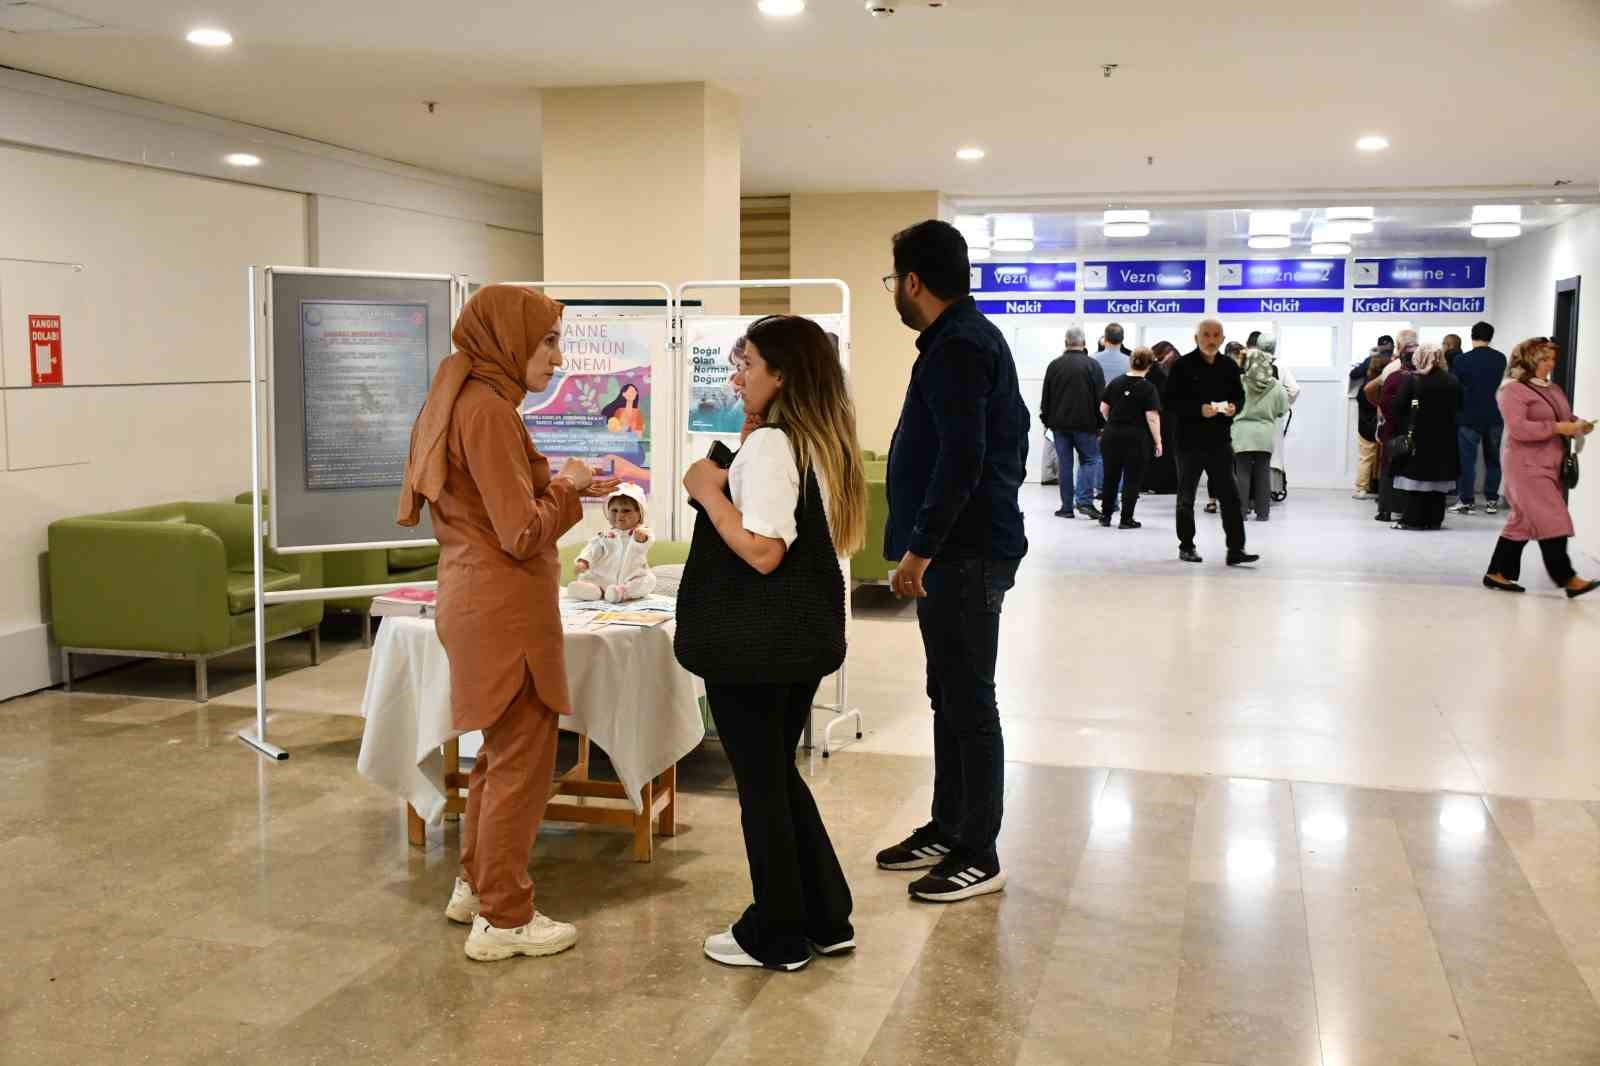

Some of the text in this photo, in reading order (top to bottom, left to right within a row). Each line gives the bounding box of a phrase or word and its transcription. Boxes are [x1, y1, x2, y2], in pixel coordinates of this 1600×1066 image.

[1183, 268, 1192, 282] 3
[1321, 268, 1330, 281] 2
[1464, 265, 1472, 279] 1
[1005, 300, 1041, 312] Nakit
[1107, 299, 1180, 312] Kredi Kartı
[1260, 299, 1300, 312] Nakit
[1354, 298, 1394, 311] Kredi
[32, 319, 59, 328] YANGIN
[564, 323, 608, 337] ANNE
[32, 331, 60, 341] DOLABI
[692, 345, 721, 357] Doğal
[692, 356, 715, 365] Olan
